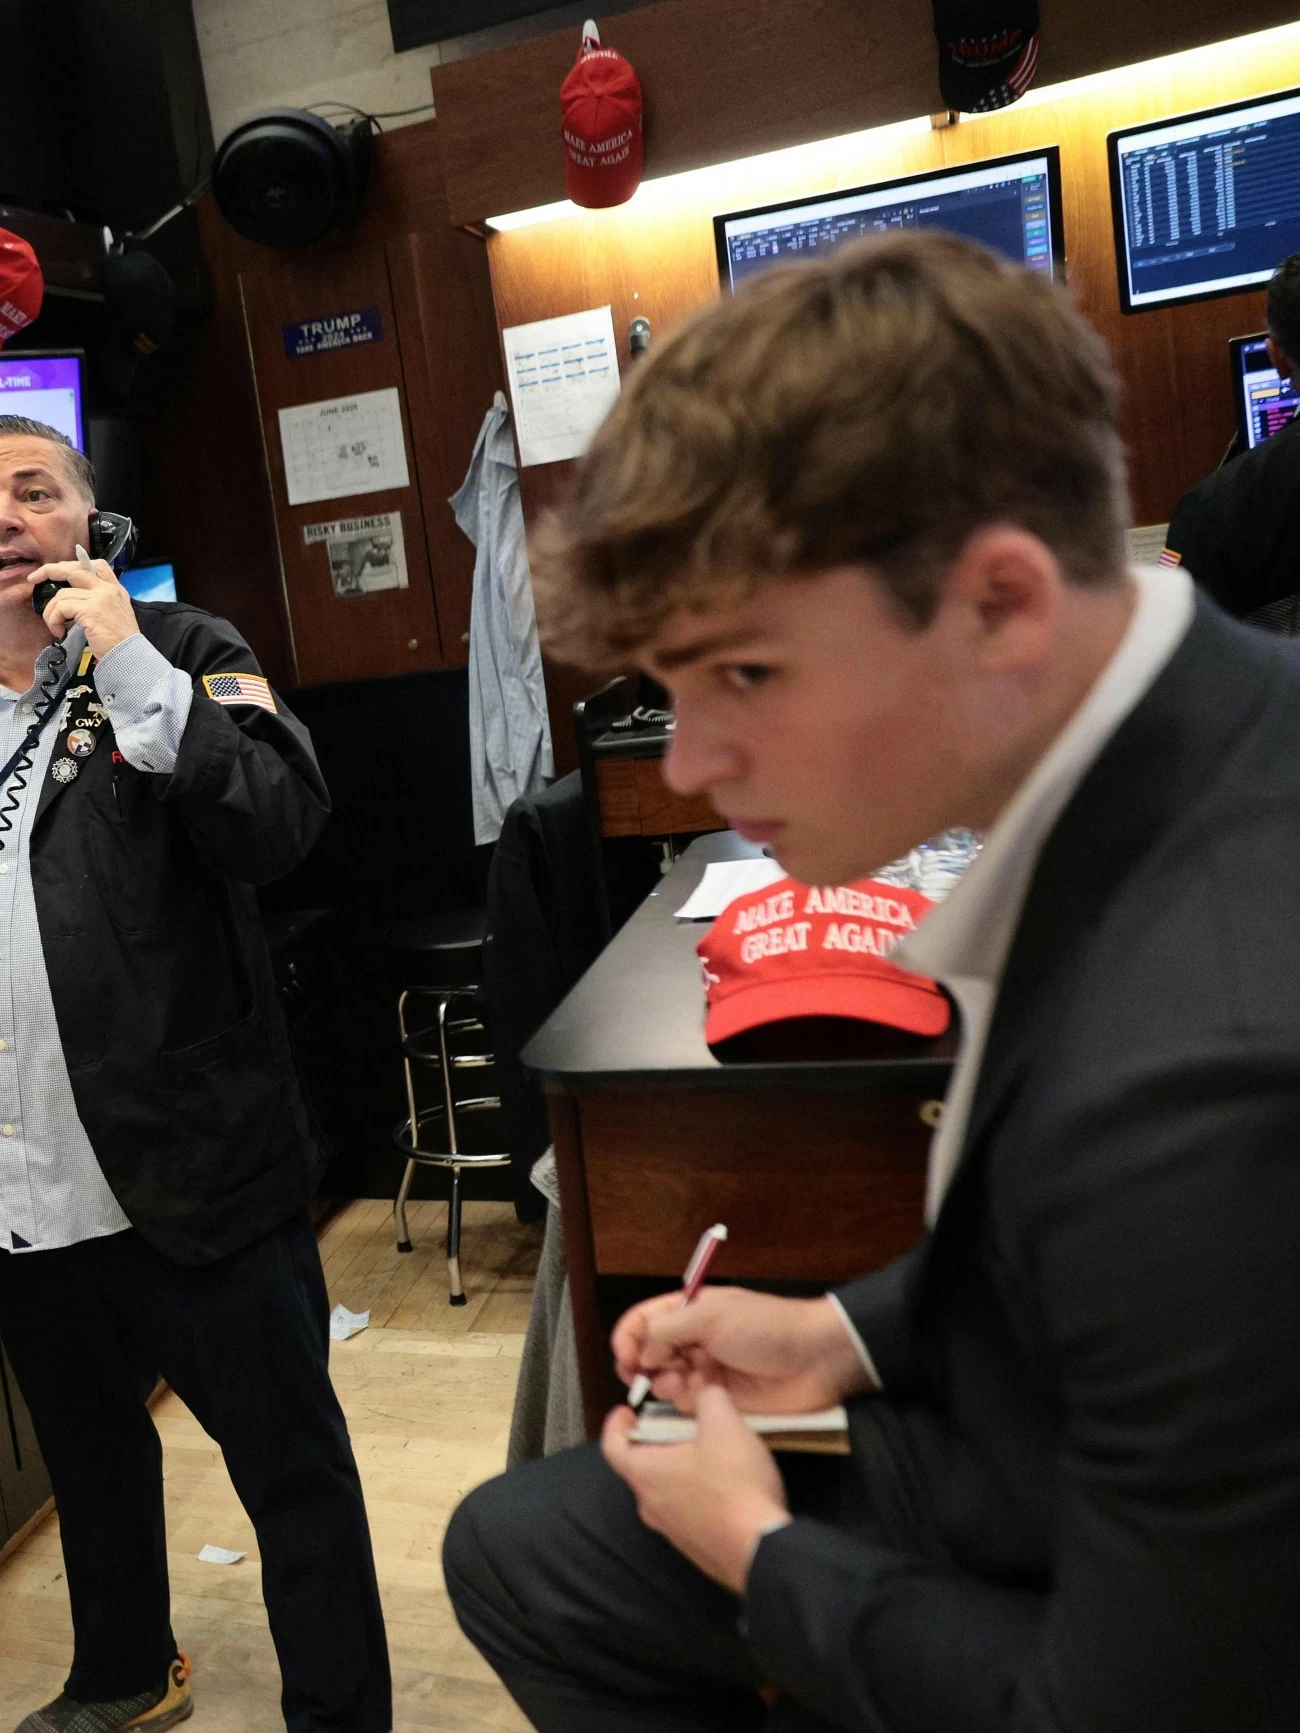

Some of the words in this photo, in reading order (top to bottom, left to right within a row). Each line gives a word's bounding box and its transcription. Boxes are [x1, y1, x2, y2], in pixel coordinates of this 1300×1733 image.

[564, 129, 586, 152] MAKE
[589, 129, 633, 154] AMERICA
[300, 313, 361, 337] TRUMP
[307, 524, 336, 538] RISKY
[340, 515, 392, 533] BUSINESS
[733, 890, 795, 936] MAKE
[803, 886, 918, 931] AMERICA
[741, 921, 812, 964] GREAT
